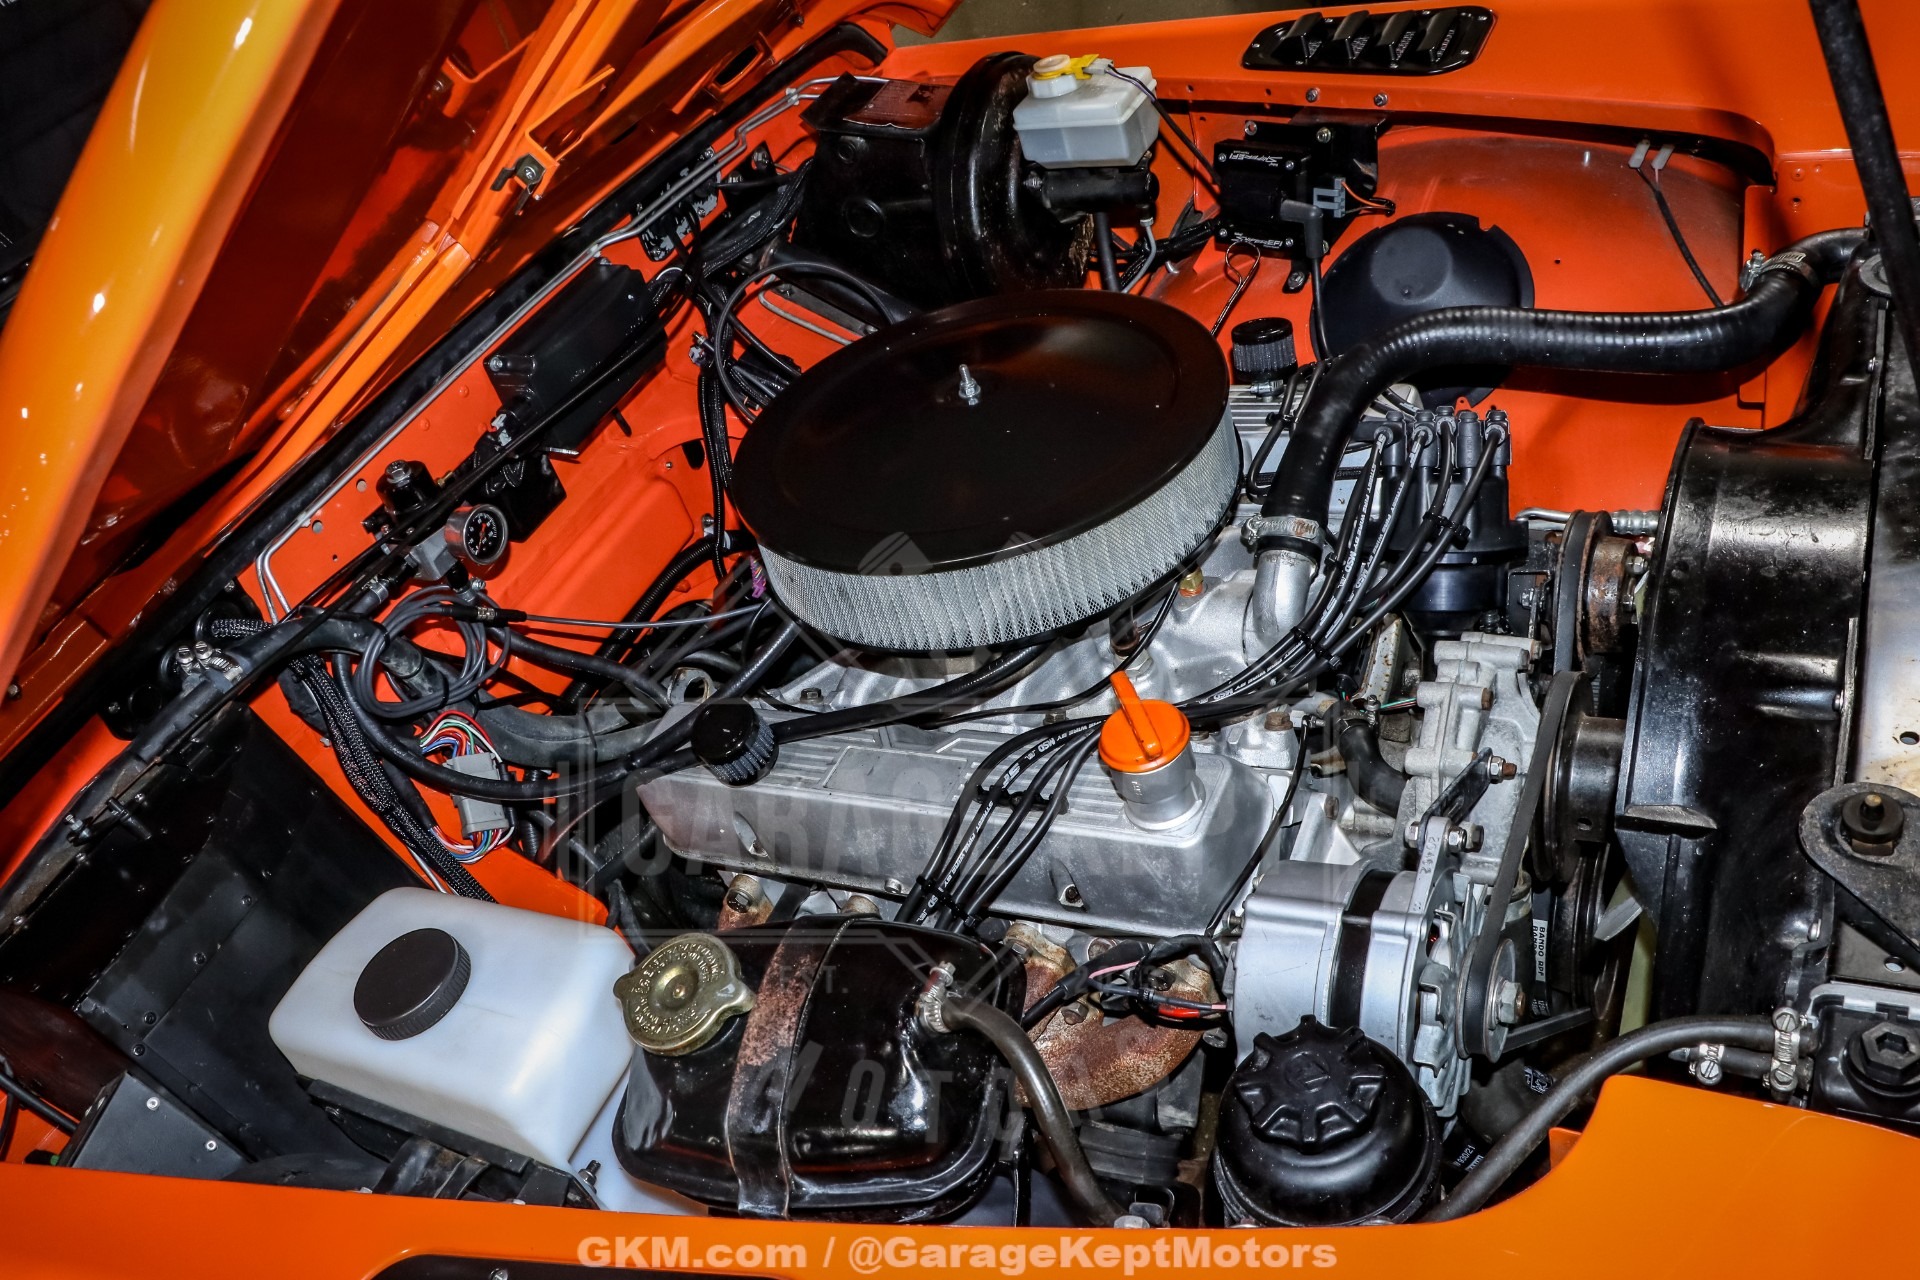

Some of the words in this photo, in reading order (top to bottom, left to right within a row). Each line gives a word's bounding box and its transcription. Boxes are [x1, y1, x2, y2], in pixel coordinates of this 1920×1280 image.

[1344, 551, 1356, 573] MSD
[1037, 737, 1056, 754] MSD
[1538, 926, 1546, 957] BANDO
